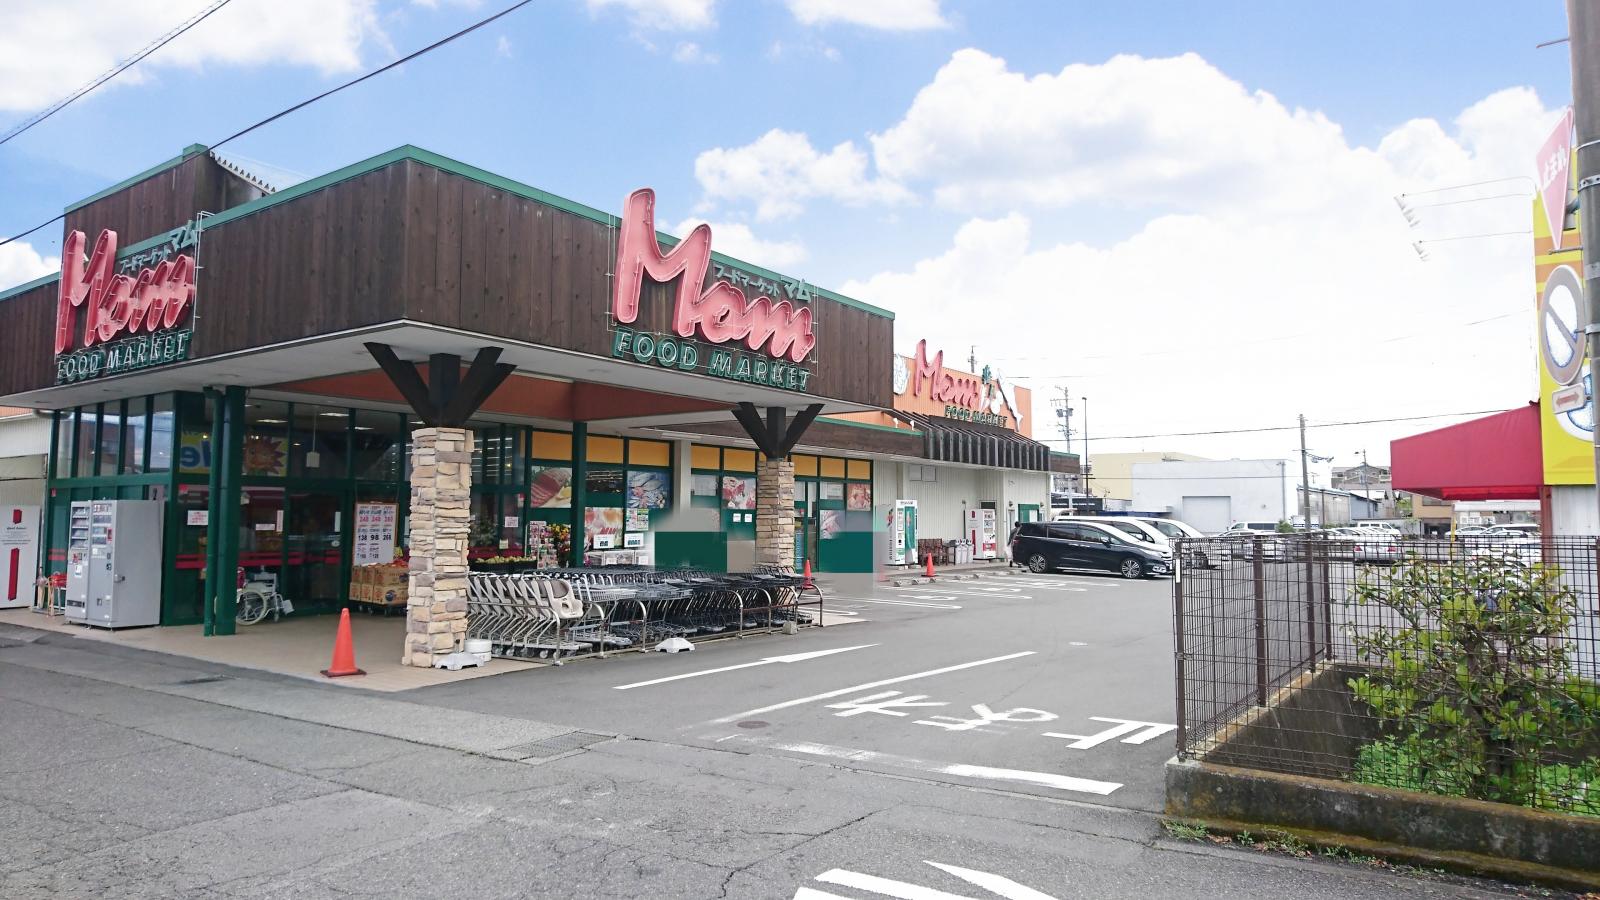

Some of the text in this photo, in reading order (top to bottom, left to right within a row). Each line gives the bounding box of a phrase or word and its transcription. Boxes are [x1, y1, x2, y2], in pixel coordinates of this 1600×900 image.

[1543, 145, 1567, 188] 止まれ
[714, 263, 780, 297] フードマーケット
[56, 329, 193, 386] FOOD MARKET
[613, 326, 811, 393] FOOD MARKET
[945, 405, 1008, 428] FOOD MARKET
